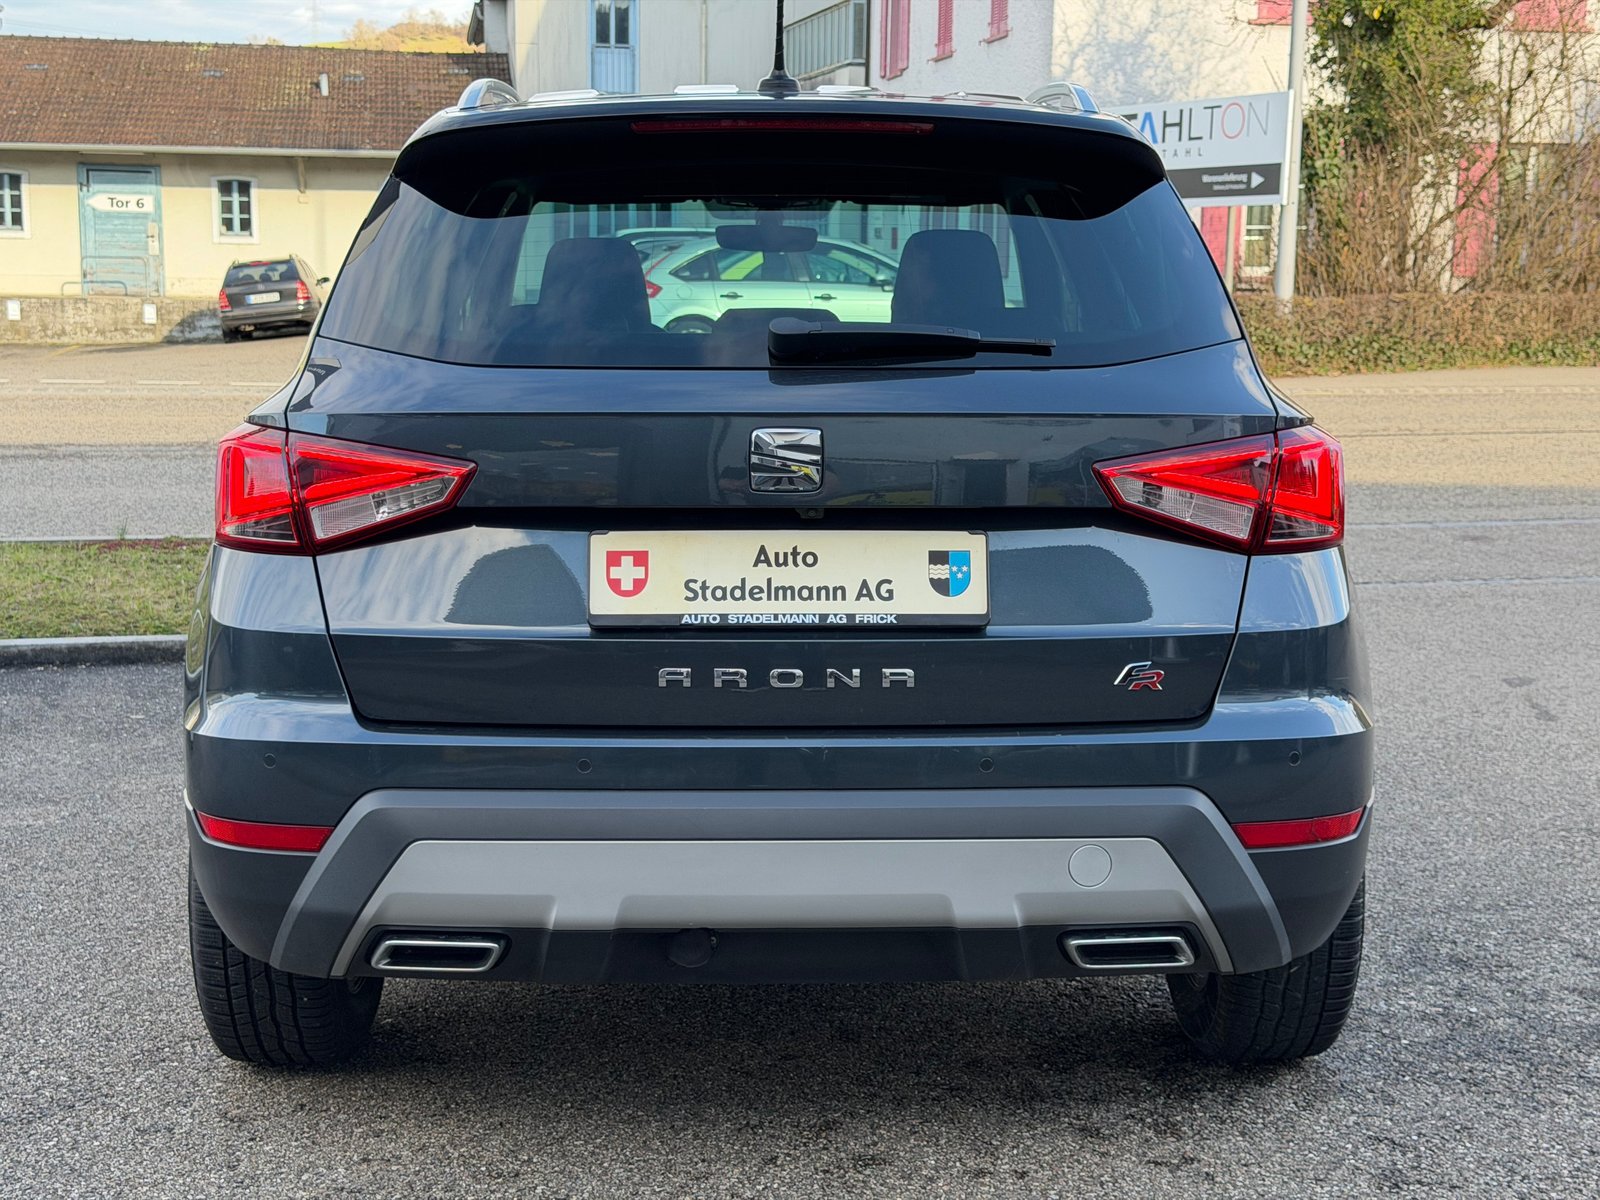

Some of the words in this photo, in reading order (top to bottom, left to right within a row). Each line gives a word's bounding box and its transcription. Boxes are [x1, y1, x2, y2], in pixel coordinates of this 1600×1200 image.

[108, 197, 130, 208] Tor
[136, 198, 144, 209] 6
[752, 544, 819, 568] Auto
[683, 577, 847, 602] Stadelmann
[854, 578, 895, 602] AG
[681, 614, 720, 624] AUTO
[727, 614, 820, 624] STADELMANN
[826, 614, 848, 624] AG
[855, 614, 898, 624] FRICK
[657, 667, 916, 689] ARONA
[1113, 661, 1165, 691] FR
